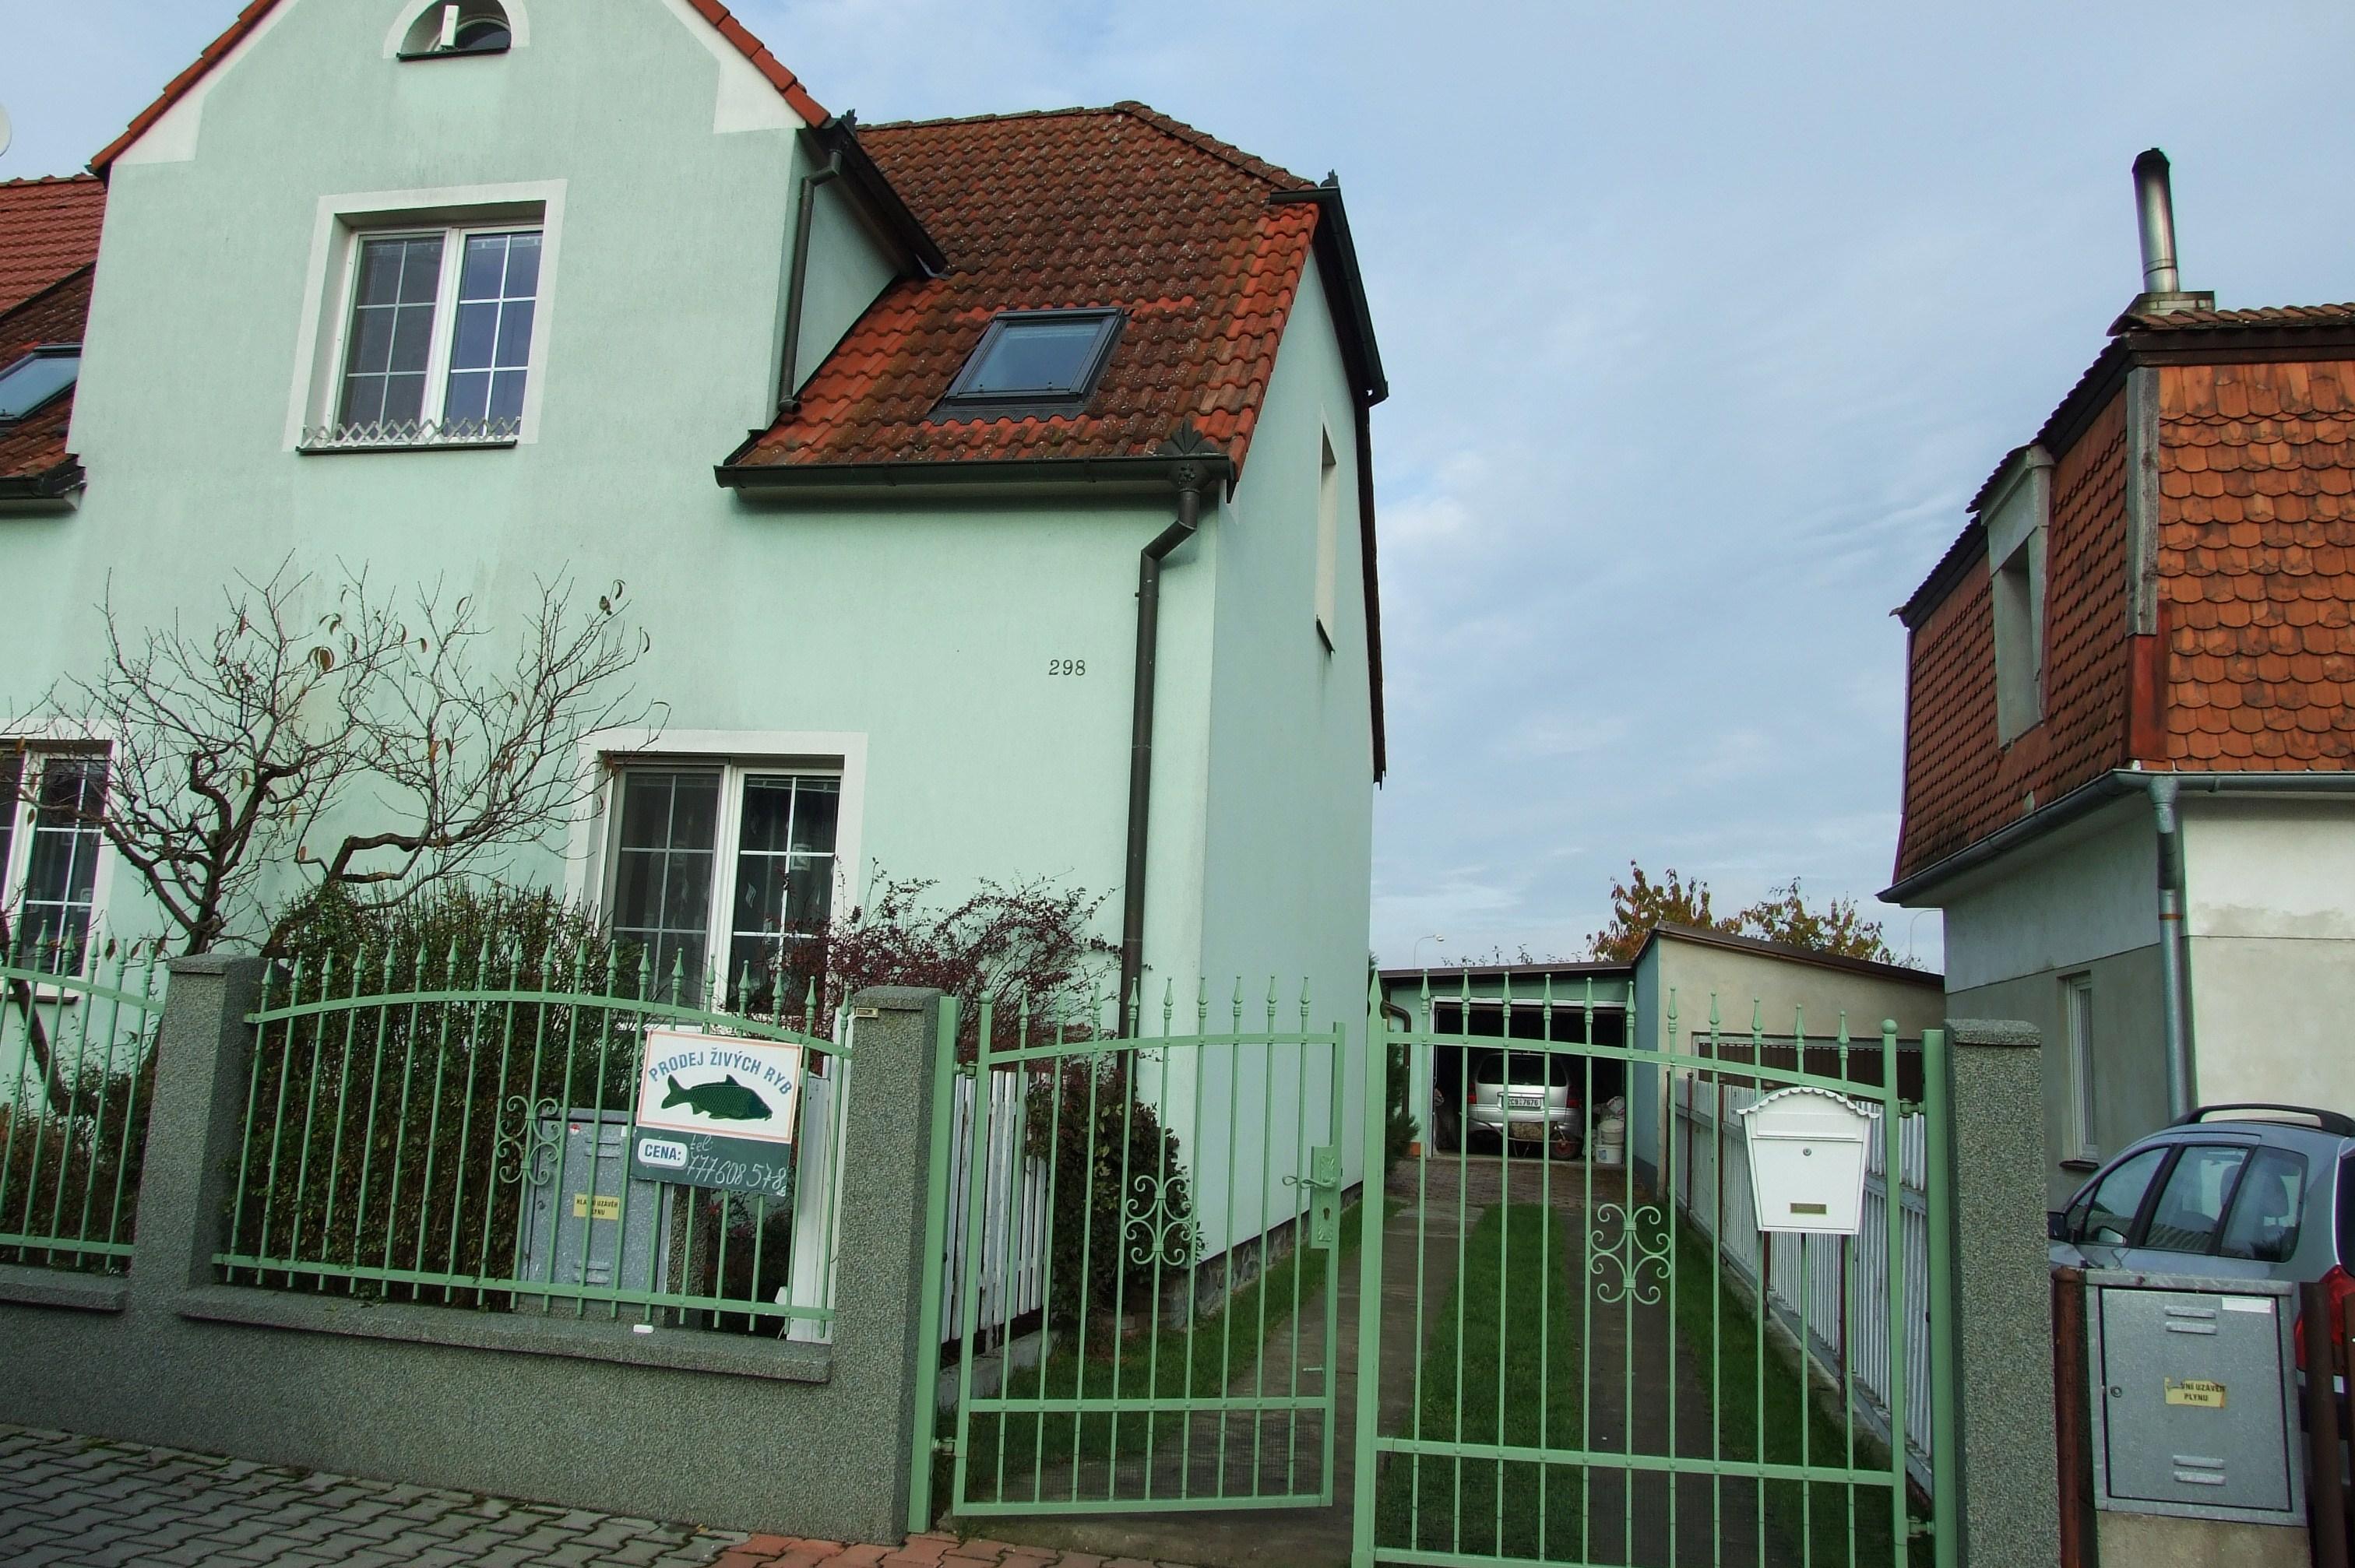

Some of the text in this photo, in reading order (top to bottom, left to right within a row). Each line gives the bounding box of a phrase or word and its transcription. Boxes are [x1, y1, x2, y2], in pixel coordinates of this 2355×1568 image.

[1048, 659, 1086, 676] 298
[649, 1047, 793, 1095] PRODEJ ŽIVÝCH RYB
[644, 1144, 681, 1161] CENA:
